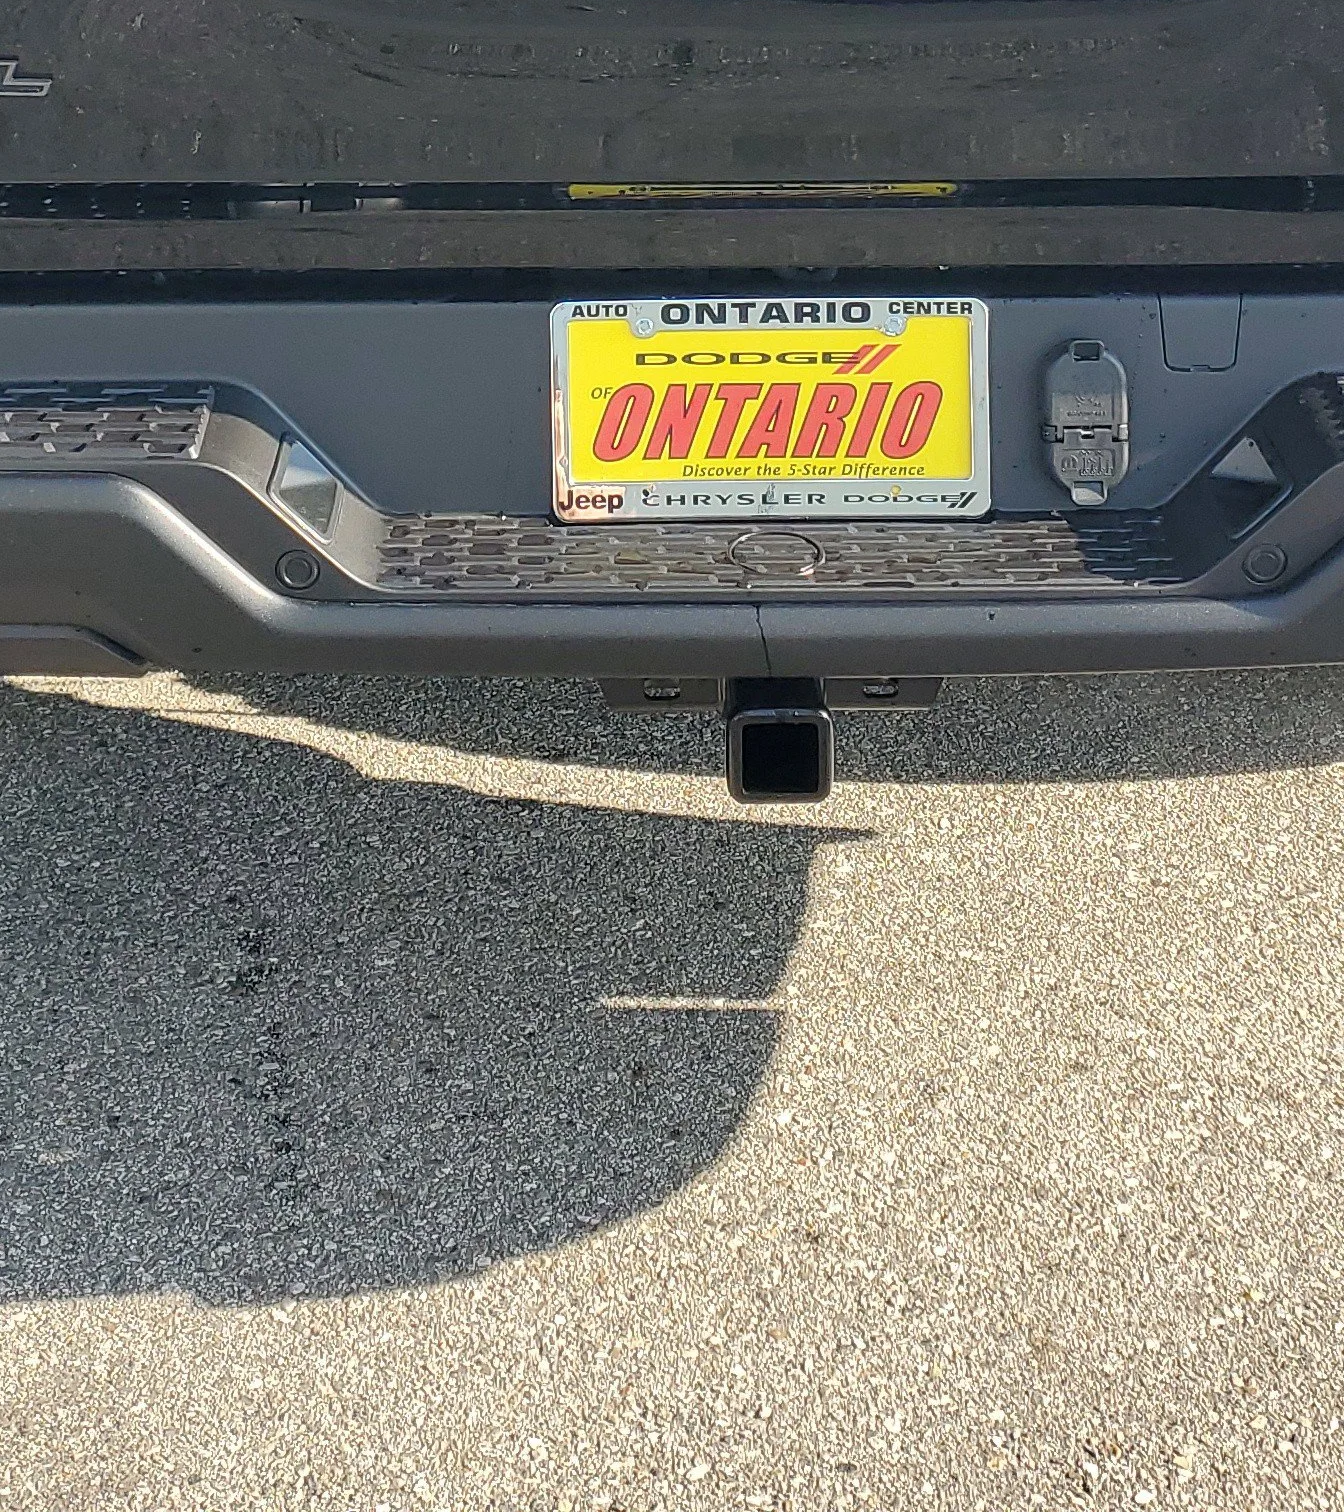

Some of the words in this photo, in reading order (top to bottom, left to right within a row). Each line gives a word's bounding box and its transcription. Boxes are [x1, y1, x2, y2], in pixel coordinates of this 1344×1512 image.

[570, 303, 629, 318] AUTO
[660, 301, 871, 325] ONTARIO
[887, 300, 974, 315] CENTER
[634, 351, 862, 366] DODGE
[590, 386, 614, 400] OF
[592, 381, 944, 463] ONTARIO
[682, 463, 752, 478] Discover
[755, 463, 782, 477] the
[787, 463, 837, 477] 5-Star
[841, 462, 926, 479] Difference
[559, 489, 624, 514] Jeep
[641, 491, 826, 507] CHRYSLER
[843, 493, 962, 504] DODGE
